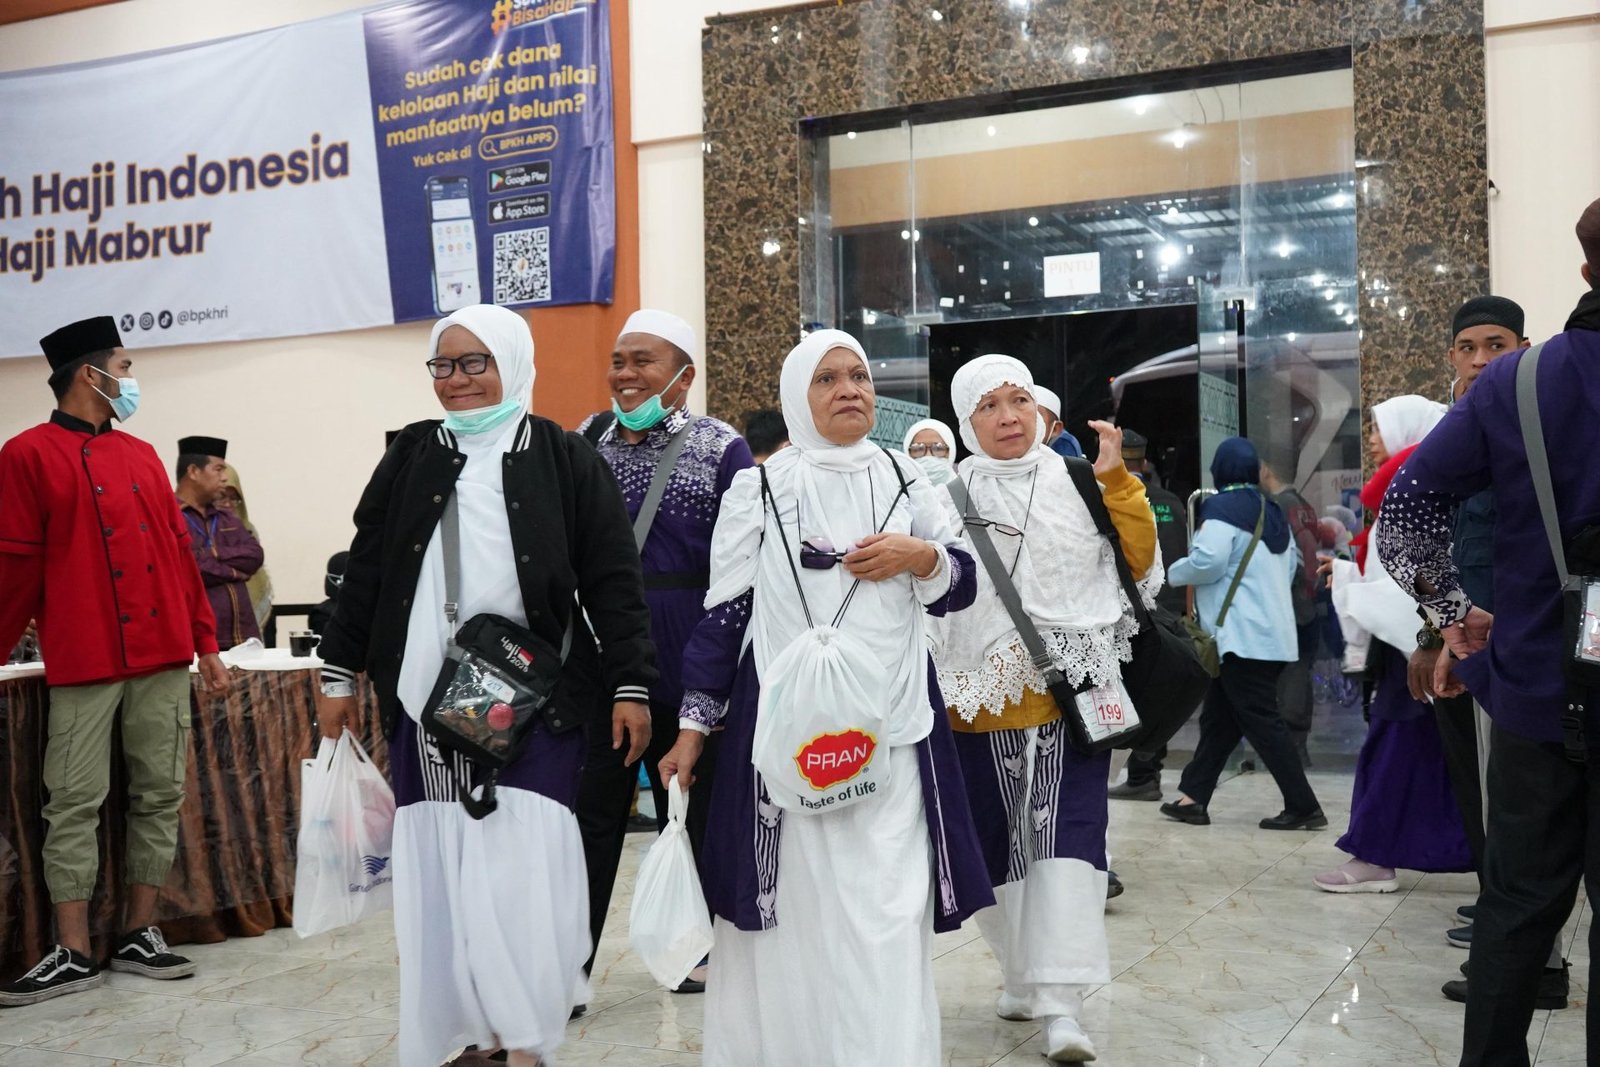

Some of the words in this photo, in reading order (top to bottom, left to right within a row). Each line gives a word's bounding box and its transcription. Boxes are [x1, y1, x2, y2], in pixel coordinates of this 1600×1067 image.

[405, 60, 466, 89] Sudah
[469, 52, 504, 75] cek
[508, 43, 561, 66] dana
[378, 92, 460, 122] kelolaan
[463, 77, 500, 104] Haji
[504, 74, 545, 95] dan
[549, 64, 597, 88] nilai
[386, 107, 505, 147] manfaatnya
[509, 93, 587, 122] belum?
[500, 135, 525, 150] BPKH
[526, 132, 552, 145] APPS
[412, 153, 434, 168] Yuk
[436, 148, 459, 164] Cek
[460, 144, 472, 159] di
[32, 160, 116, 223] Haji
[126, 132, 350, 206] Indonesia
[505, 173, 530, 186] Google
[531, 171, 547, 182] Play
[505, 207, 522, 219] App
[522, 204, 545, 216] Store
[65, 222, 212, 268] Mabrur
[1049, 259, 1094, 274] PINTU
[177, 305, 228, 326] @bpkhri
[1098, 703, 1122, 721] 199
[806, 742, 867, 770] PRAN
[796, 793, 835, 810] Taste
[838, 786, 852, 801] of
[854, 781, 876, 797] life
